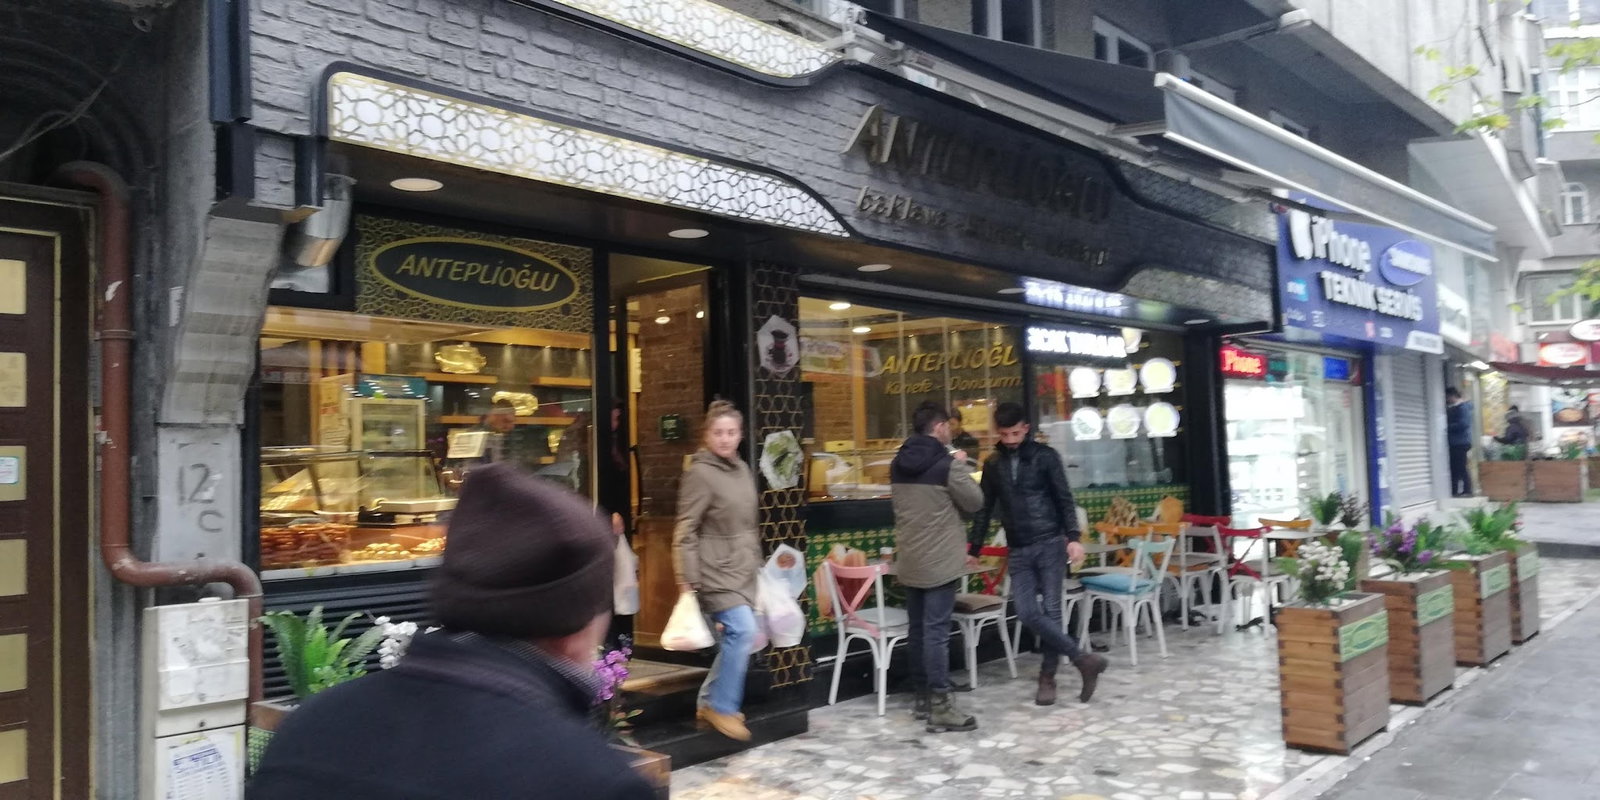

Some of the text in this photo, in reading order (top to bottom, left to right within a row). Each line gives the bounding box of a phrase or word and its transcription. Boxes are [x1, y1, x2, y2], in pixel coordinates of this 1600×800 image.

[395, 254, 560, 292] ANTEPLİOĞLU
[1321, 270, 1378, 311] TEKNİK
[1376, 286, 1424, 322] SERVİS
[880, 342, 1020, 376] ANTEPLİOĞL
[949, 376, 1023, 391] Dondurm
[177, 463, 215, 506] 12
